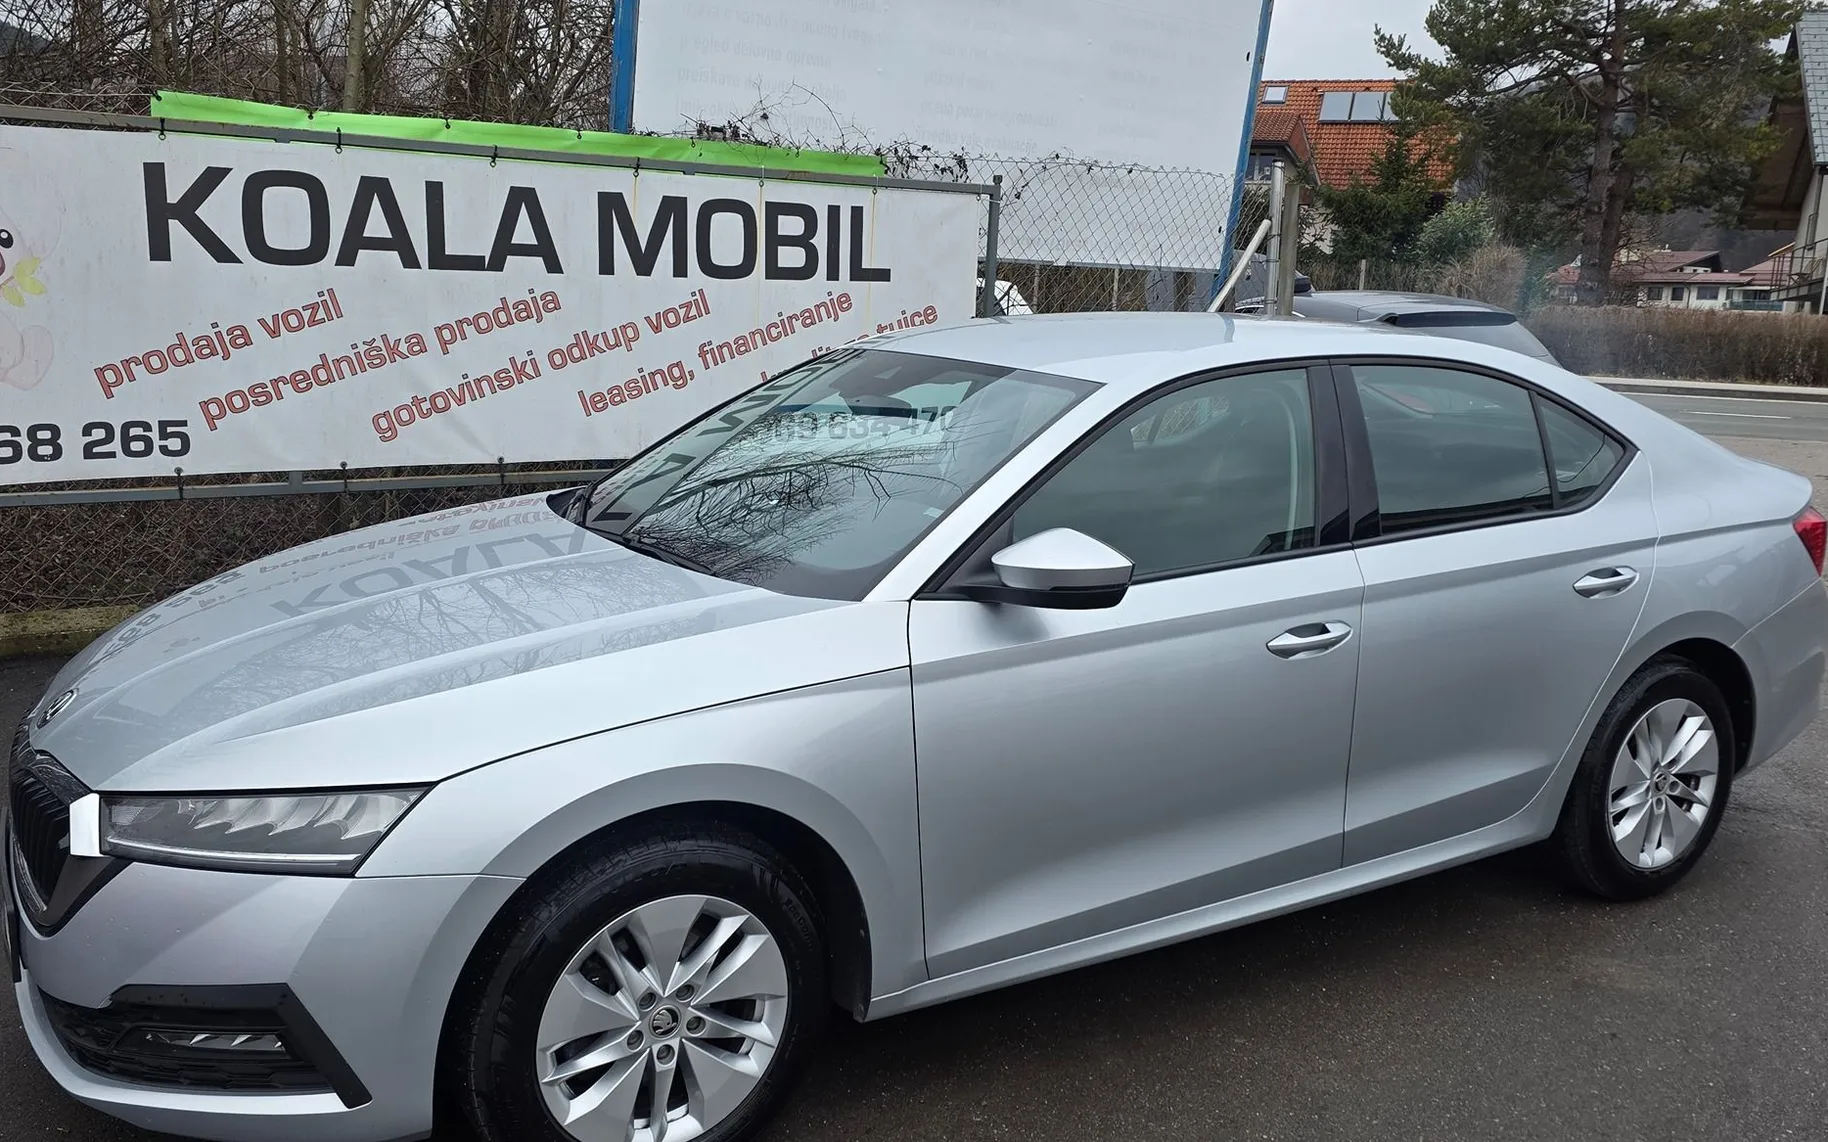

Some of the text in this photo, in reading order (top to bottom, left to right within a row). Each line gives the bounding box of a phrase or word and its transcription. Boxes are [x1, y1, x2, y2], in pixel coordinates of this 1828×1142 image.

[143, 162, 891, 282] KOALA MOBIL
[94, 288, 345, 399] prodaja vozil
[198, 289, 562, 431] posredniška prodaja
[371, 288, 711, 443] gotovinski odkup vozil
[577, 358, 695, 418] leasing,
[698, 289, 854, 371] financiranje
[81, 419, 191, 460] 265
